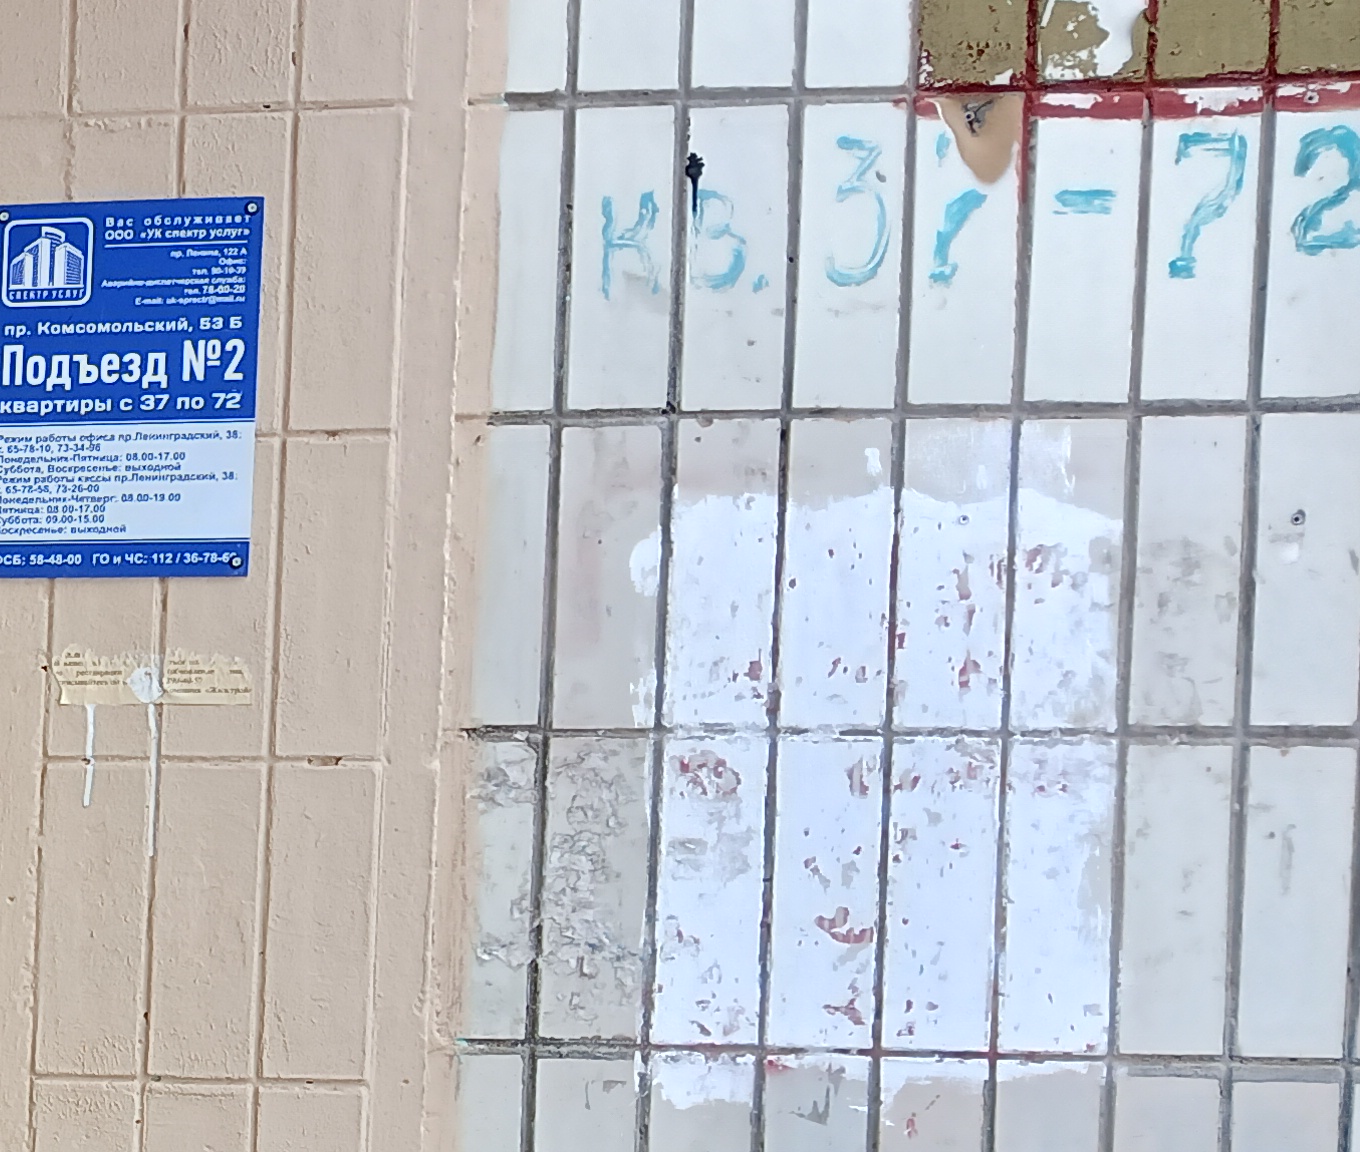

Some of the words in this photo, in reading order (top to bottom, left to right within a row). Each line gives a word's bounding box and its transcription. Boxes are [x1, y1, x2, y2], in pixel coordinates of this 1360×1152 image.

[105, 217, 134, 228] Вас
[144, 214, 251, 226] обслуживает
[105, 230, 134, 240] ООО
[140, 229, 162, 239] «УК
[165, 229, 207, 240] спектр
[209, 228, 250, 239] услуг»
[9, 289, 50, 300] СПЕКТР
[52, 288, 85, 299] УСЛУГ
[4, 324, 32, 338] пр.
[37, 319, 193, 335] Комсомольский,
[199, 318, 224, 330] 53
[229, 317, 243, 328] Б
[2, 345, 168, 391] Подъезд
[182, 338, 246, 381] №2
[0, 398, 112, 416] квартиры
[120, 398, 133, 411] с
[139, 395, 169, 410] 37
[176, 396, 205, 409] по
[211, 392, 242, 408] 72
[36, 434, 76, 444] работы
[79, 433, 115, 445] офиса
[125, 452, 186, 461] 08.00-17.00
[47, 464, 122, 474] Воскресенье:
[125, 463, 181, 472] выходной
[34, 475, 75, 485] работы
[78, 474, 112, 483] кассы
[71, 525, 126, 534] выходной
[29, 554, 82, 565] 58-48-00
[92, 554, 109, 565] ГО
[113, 555, 122, 564] и
[125, 553, 148, 564] ЧС:
[152, 553, 173, 564] 112
